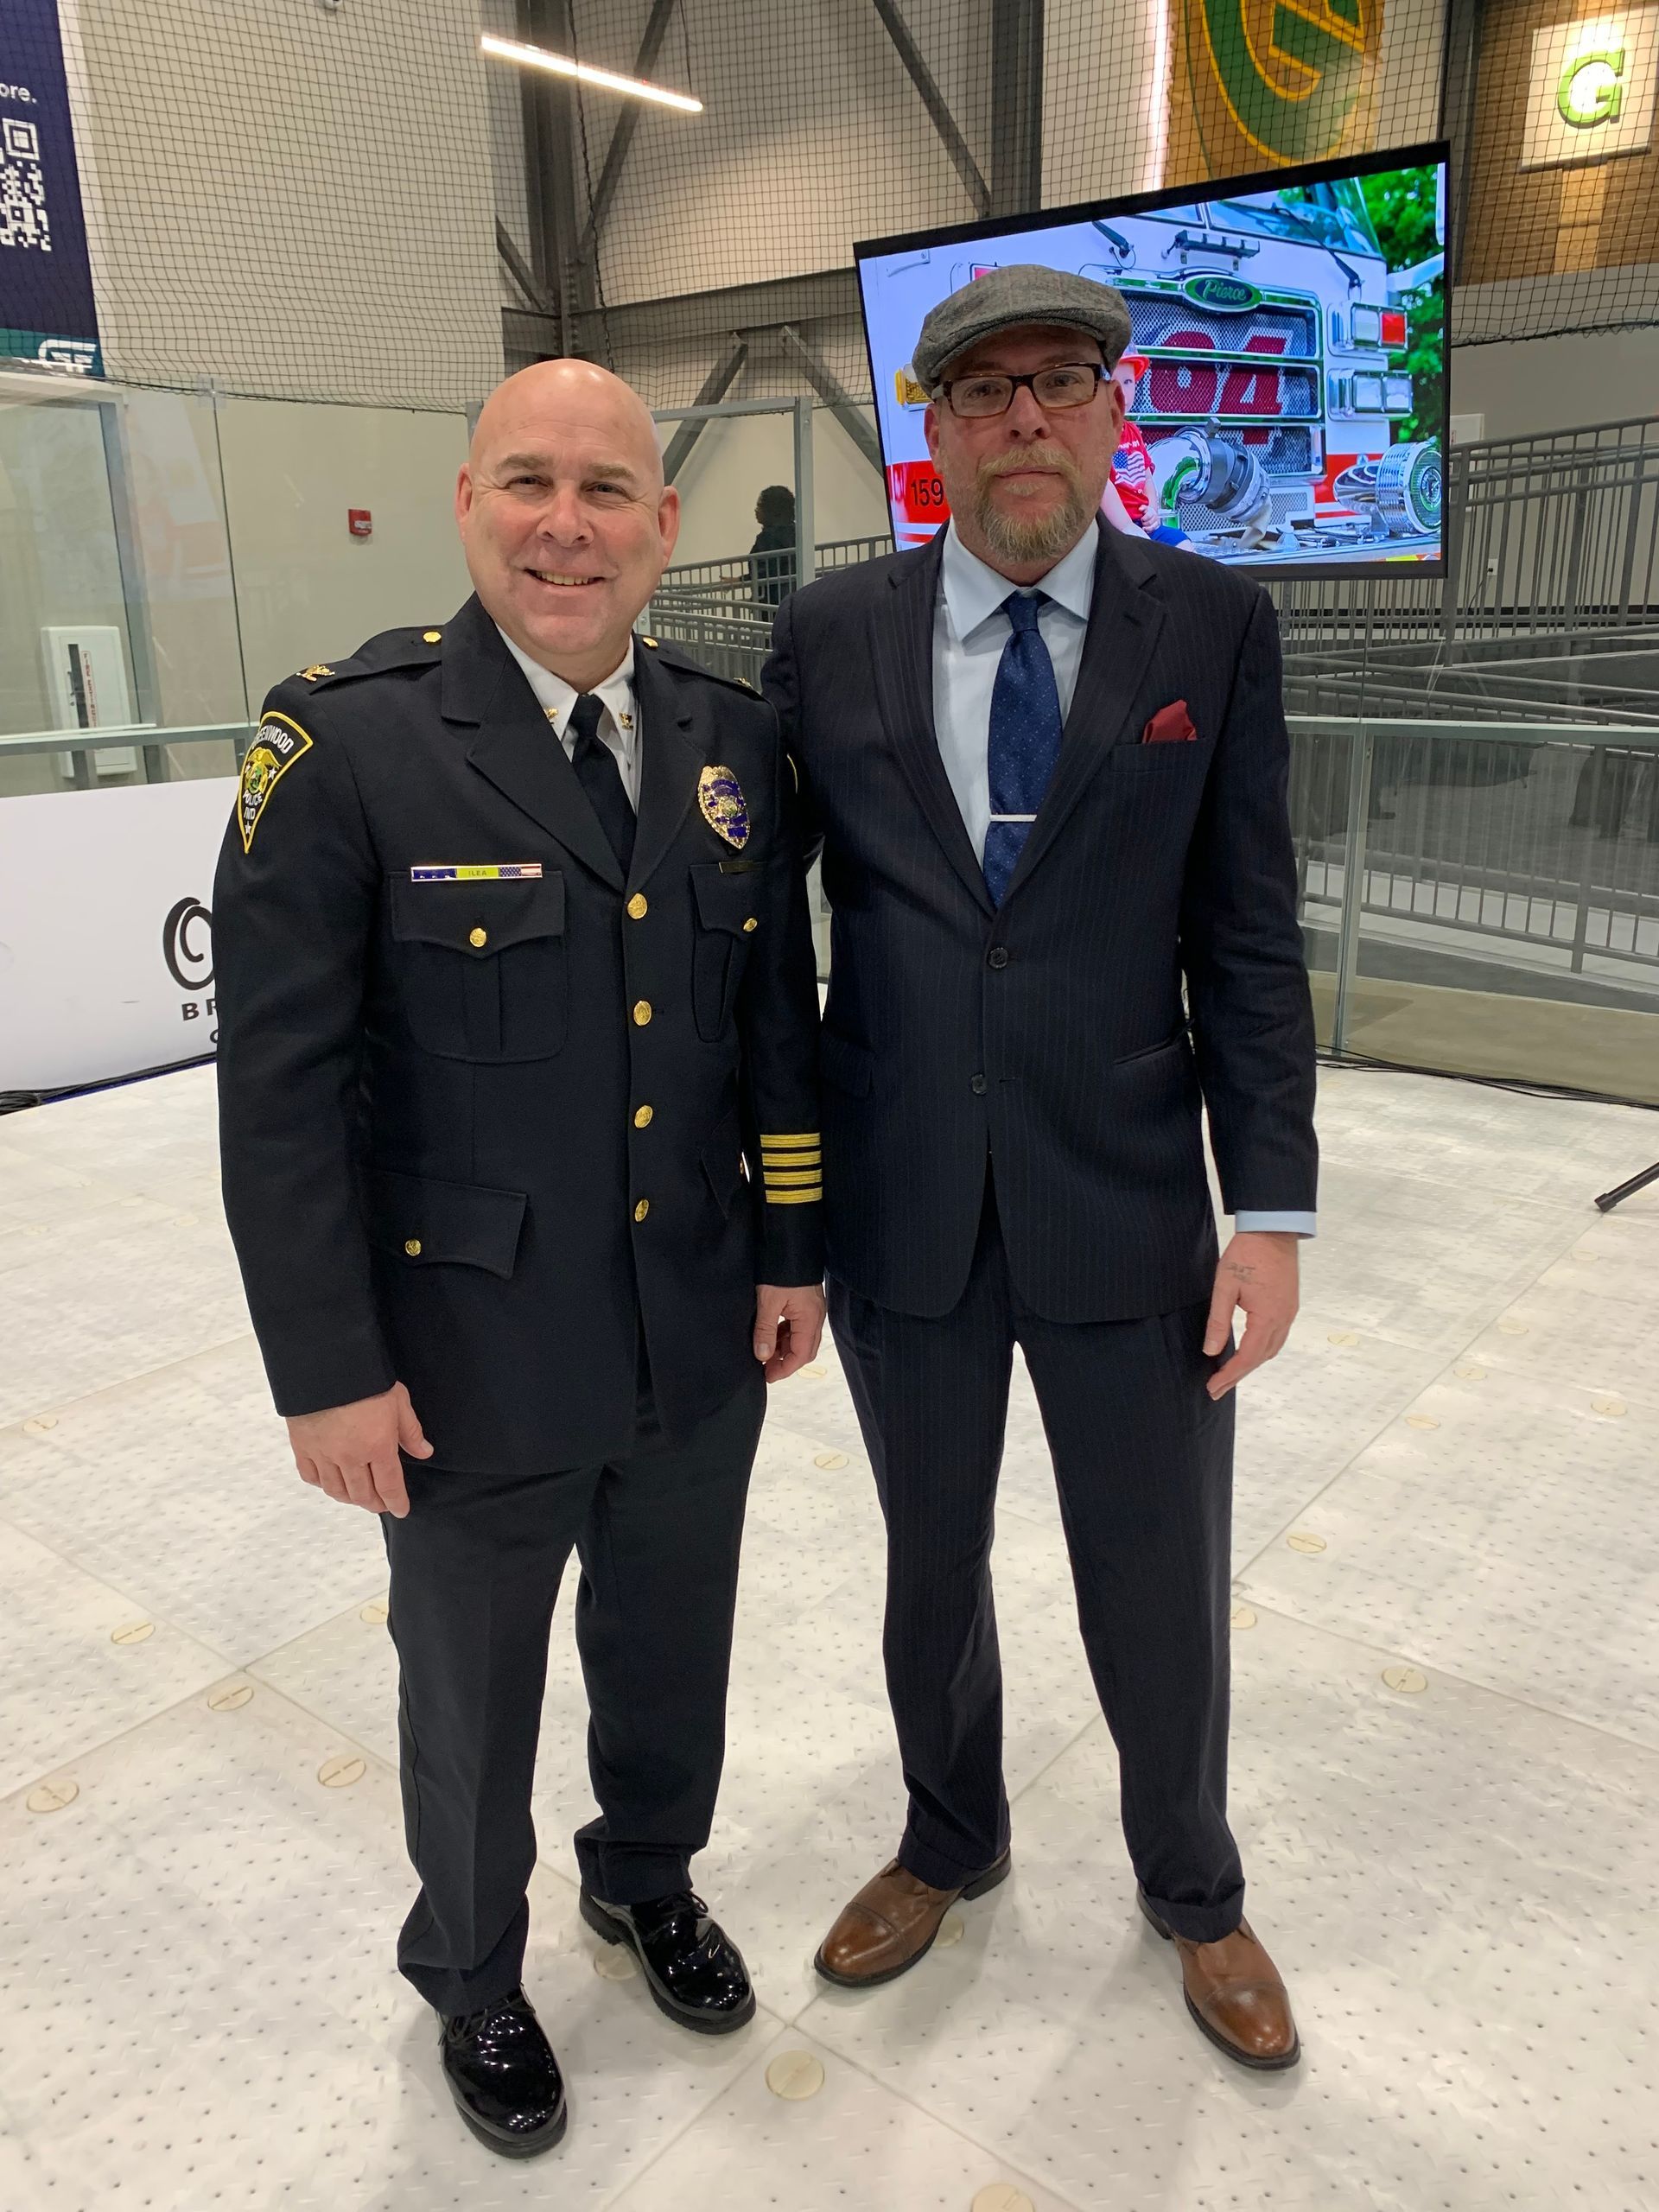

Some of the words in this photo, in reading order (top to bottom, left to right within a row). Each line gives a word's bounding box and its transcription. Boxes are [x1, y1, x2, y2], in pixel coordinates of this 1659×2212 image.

[1558, 49, 1624, 126] G
[1202, 279, 1247, 301] Pierce
[911, 478, 944, 506] 159
[251, 725, 294, 754] EENWOOD
[242, 789, 264, 806] POLICE
